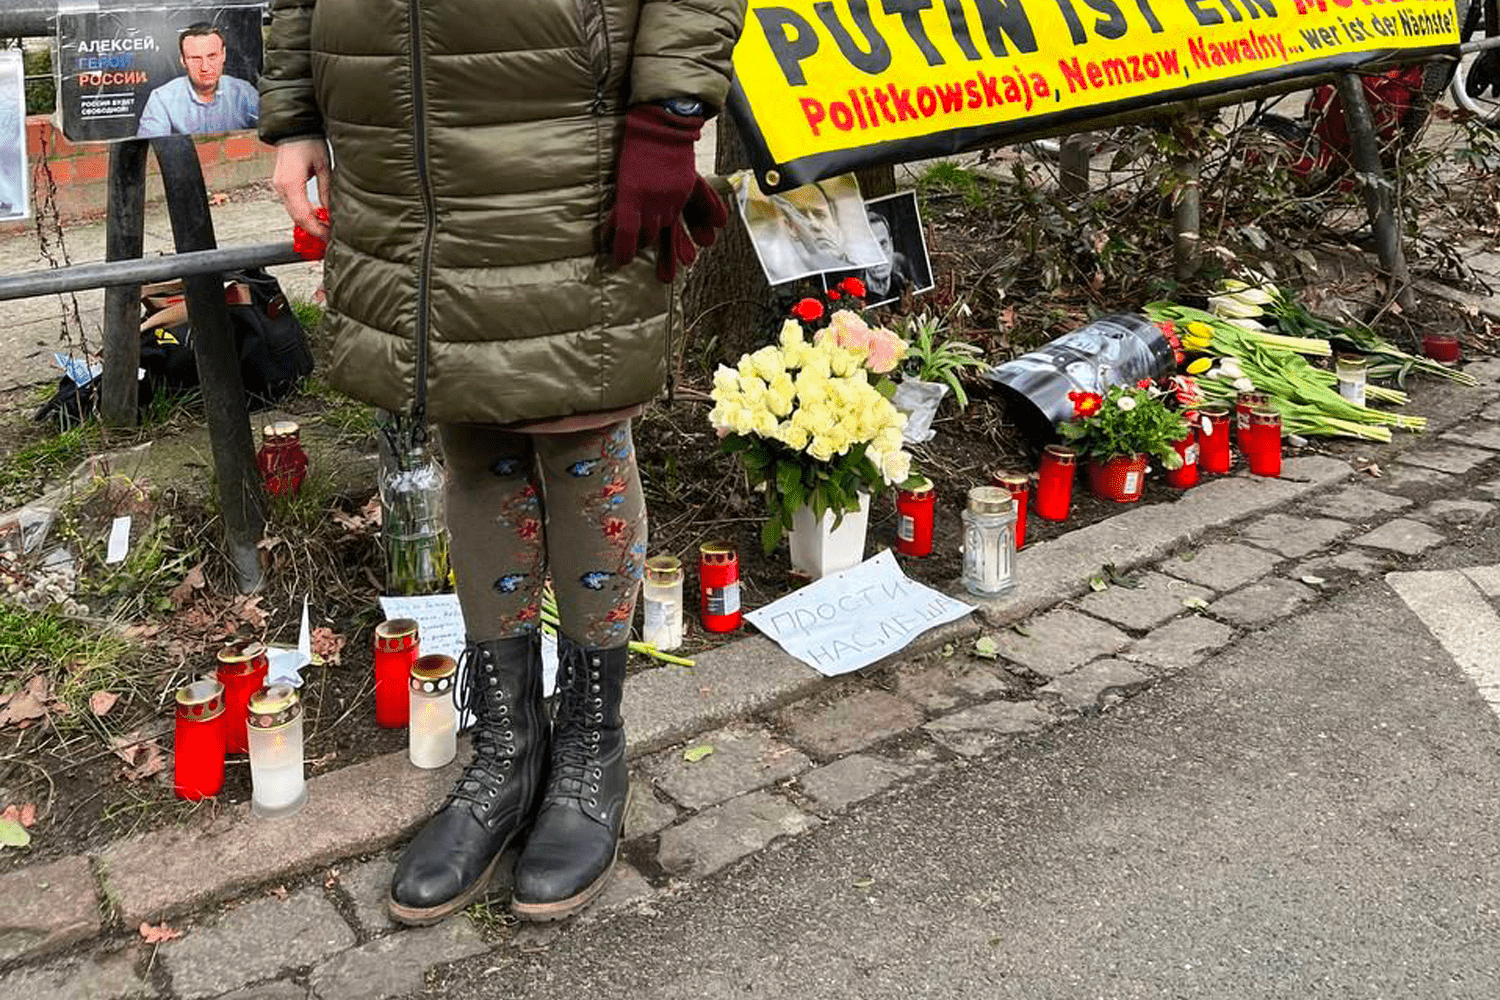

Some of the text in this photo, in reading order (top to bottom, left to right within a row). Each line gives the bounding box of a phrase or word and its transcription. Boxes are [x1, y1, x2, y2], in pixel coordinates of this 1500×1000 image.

[78, 36, 160, 53] АЛЕКСЕЙ,
[79, 71, 148, 88] РОССИИ
[799, 64, 1061, 137] Politkowskaja,
[1058, 47, 1190, 95] Nemzow,
[1299, 24, 1341, 51] wer
[1337, 14, 1374, 44] ist
[1371, 13, 1398, 39] der
[770, 580, 909, 637] ПРОСТИ
